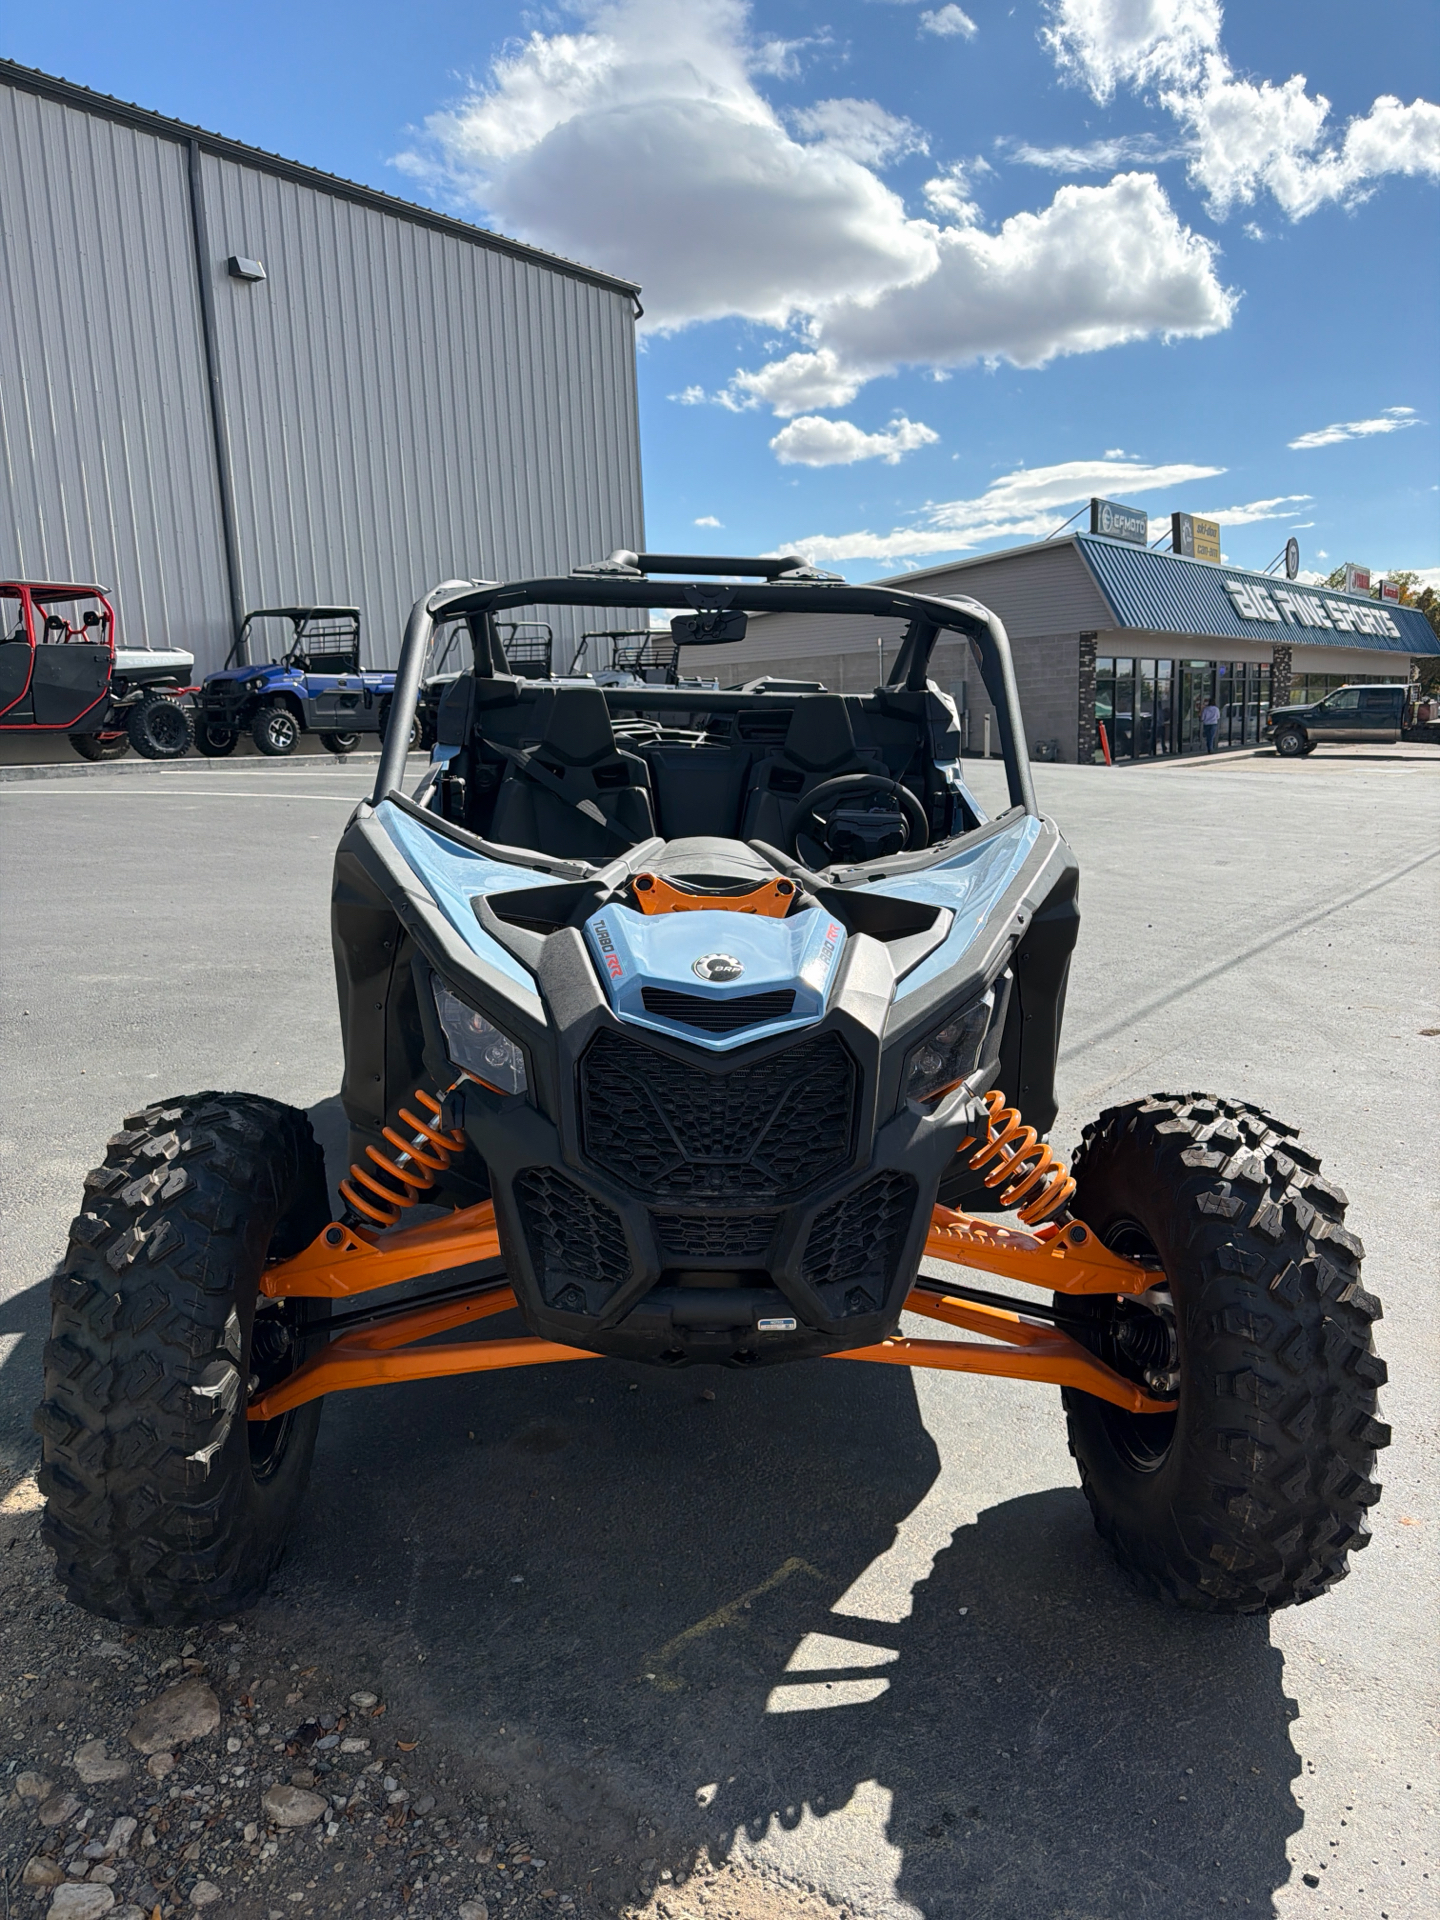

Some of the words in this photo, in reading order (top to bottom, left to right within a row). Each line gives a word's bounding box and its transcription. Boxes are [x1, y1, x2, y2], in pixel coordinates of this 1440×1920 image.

[1113, 514, 1146, 534] CFMOTO
[1223, 579, 1282, 623] BIG
[1271, 589, 1334, 629] PINE
[1322, 599, 1401, 638] SPORTS
[826, 923, 840, 943] RR
[592, 919, 615, 953] TURBO
[604, 953, 623, 979] RR
[714, 965, 742, 973] BRP
